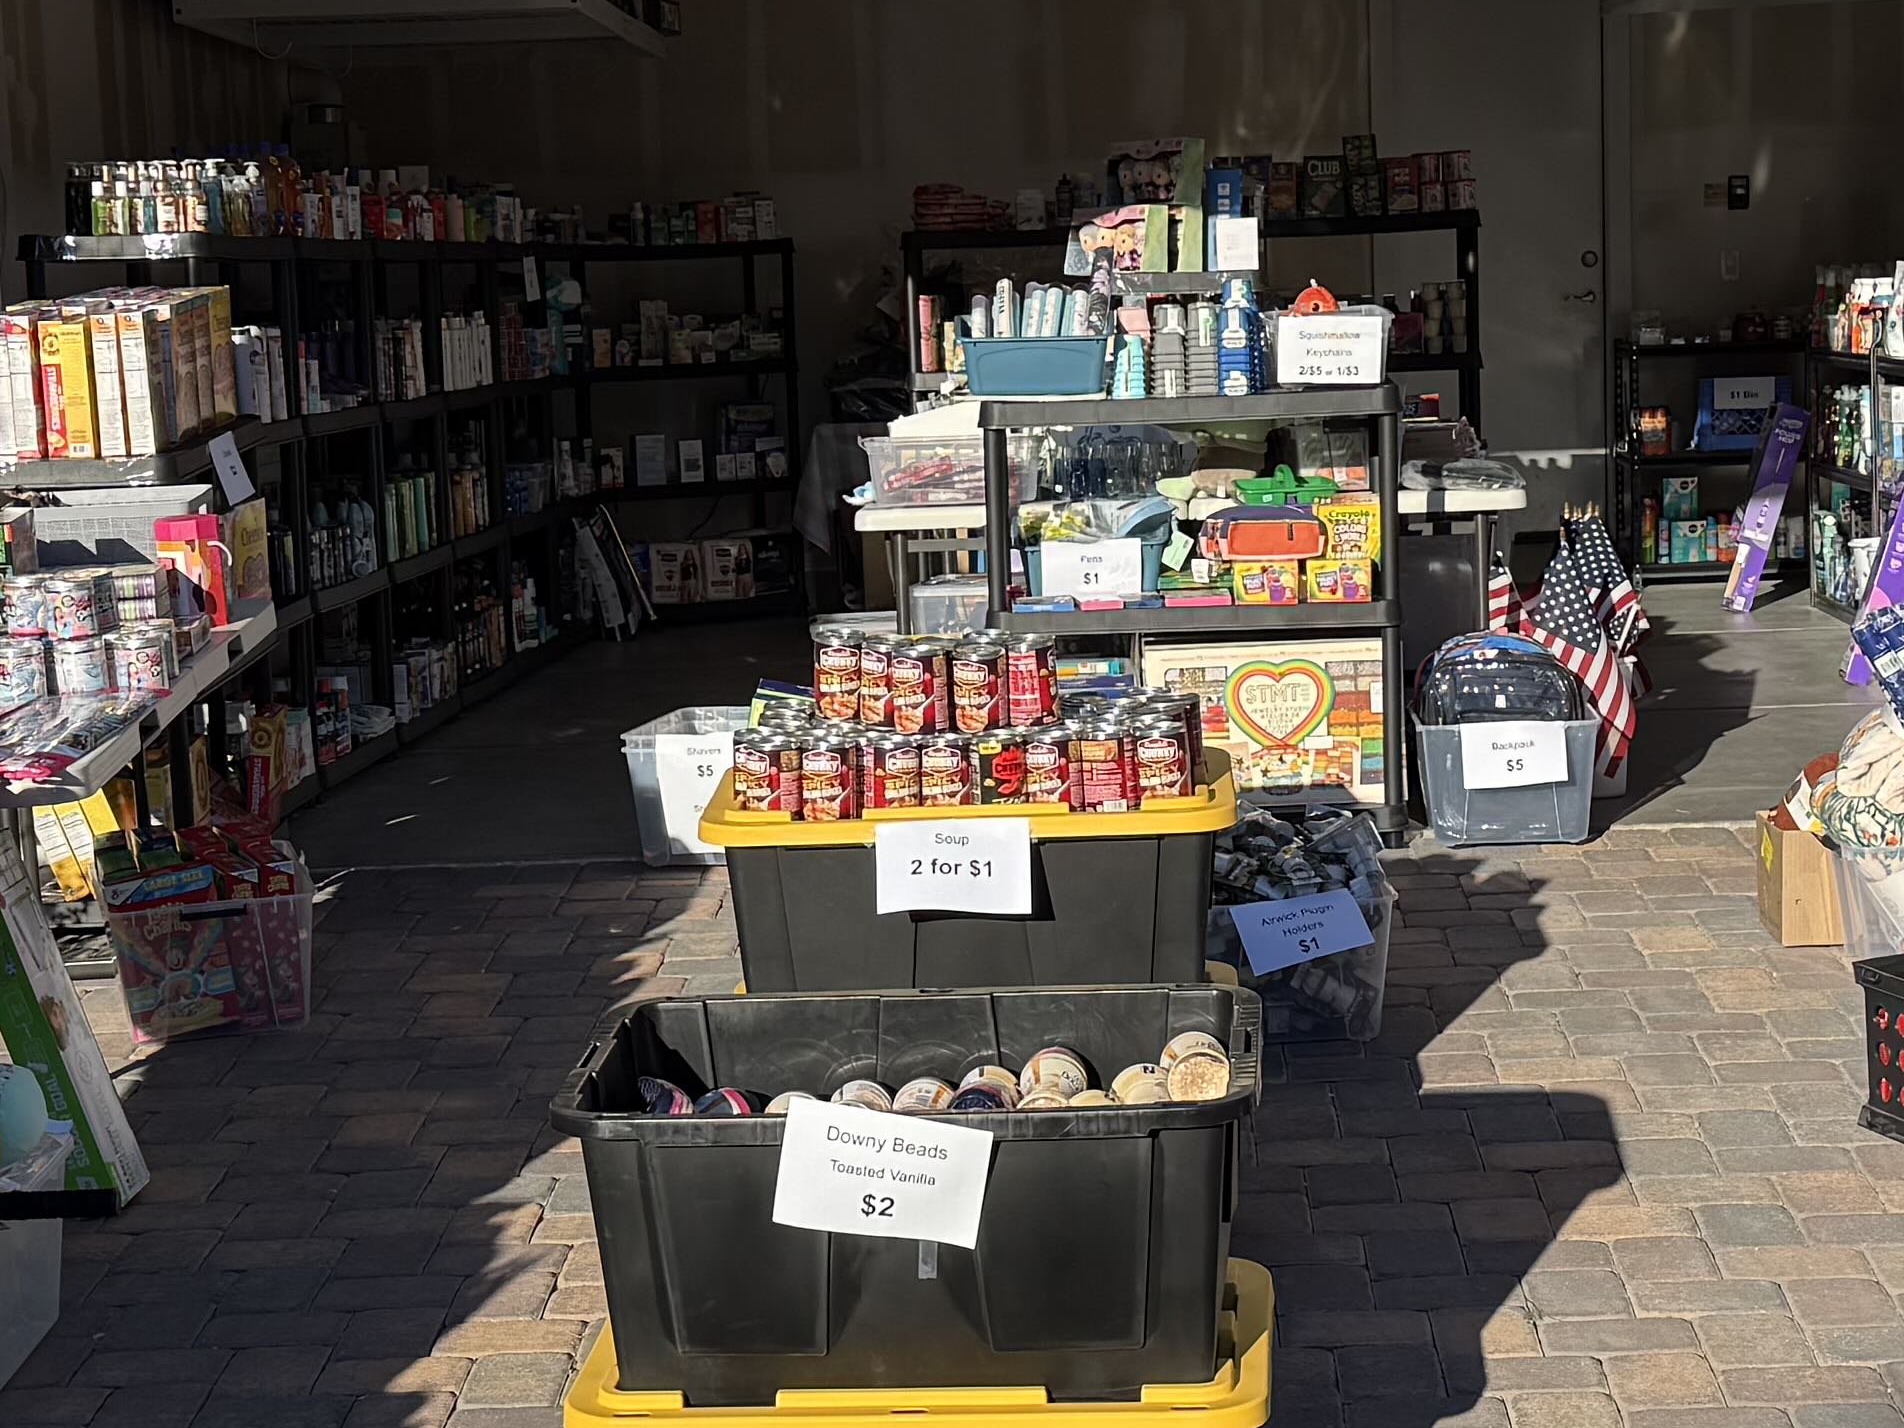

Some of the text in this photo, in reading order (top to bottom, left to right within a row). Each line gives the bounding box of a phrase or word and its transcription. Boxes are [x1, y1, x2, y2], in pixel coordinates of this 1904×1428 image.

[1299, 366, 1322, 376] 2/$5
[1083, 572, 1099, 586] $1
[1245, 683, 1300, 705] STMT
[697, 765, 714, 778] $5
[1506, 759, 1524, 772] $5
[934, 832, 970, 847] Soup
[910, 858, 993, 878] 2 for $1
[1282, 921, 1325, 938] Holders
[1298, 936, 1321, 954] $1
[827, 1126, 949, 1161] Downy Beads
[830, 1159, 937, 1186] Toasted Vanilla
[860, 1194, 895, 1218] $2
